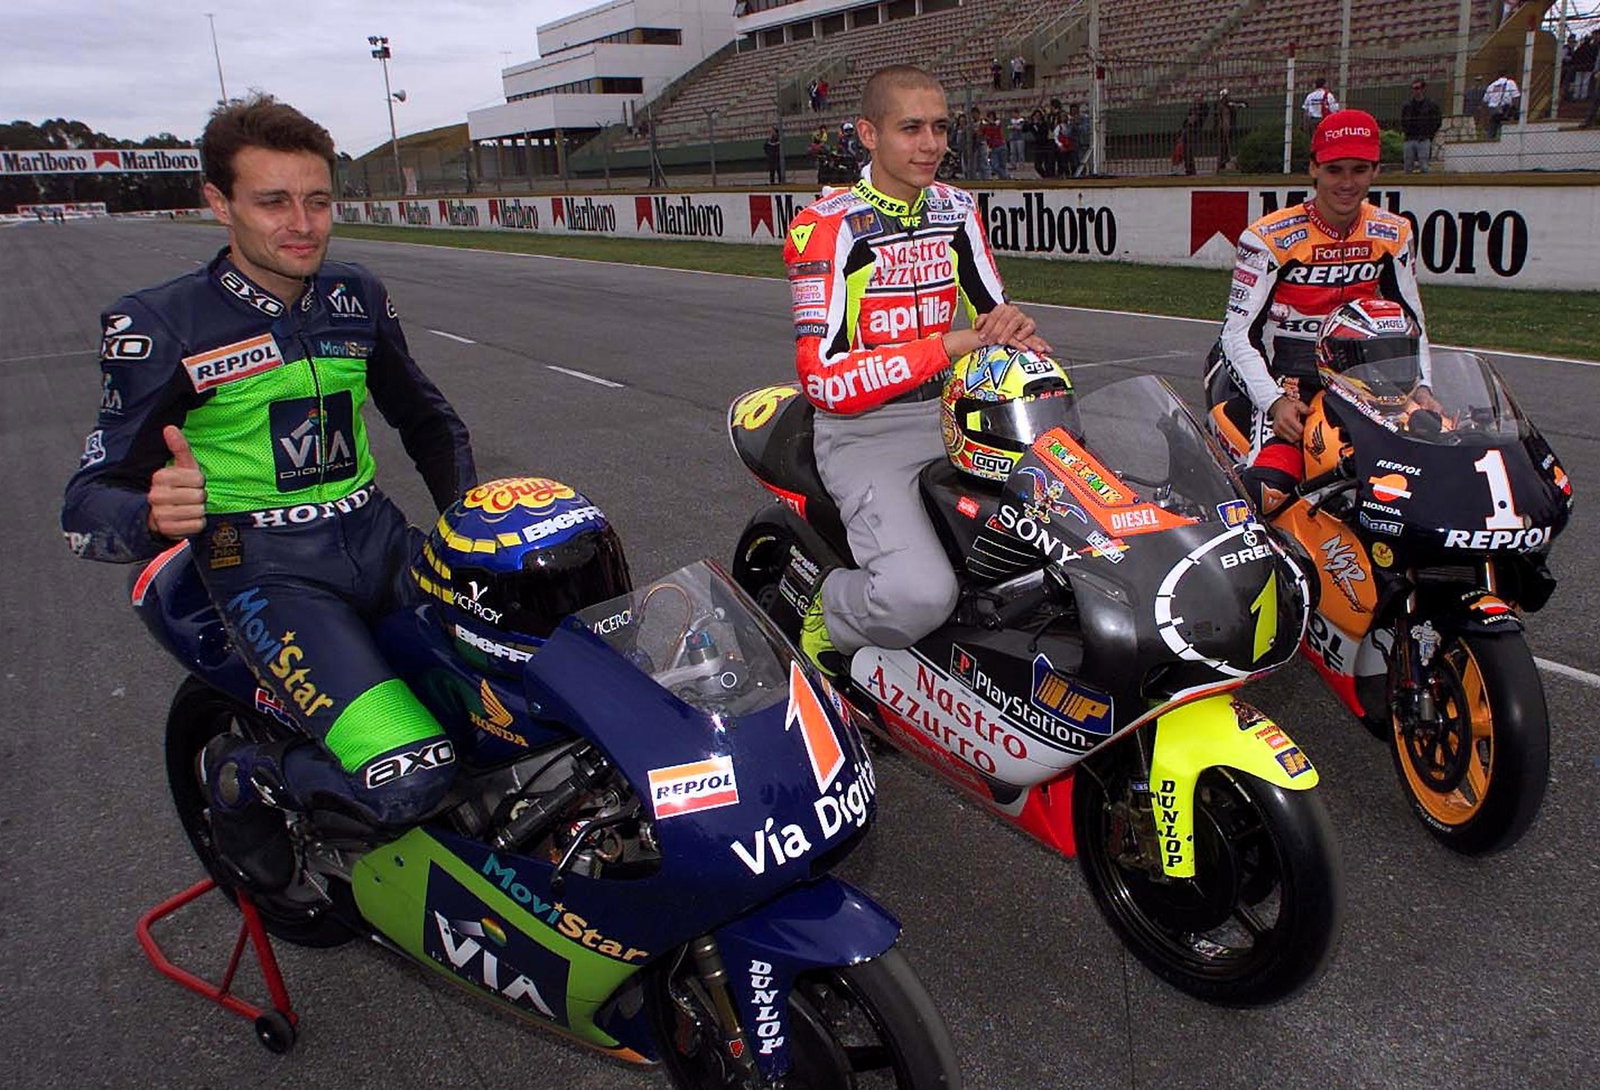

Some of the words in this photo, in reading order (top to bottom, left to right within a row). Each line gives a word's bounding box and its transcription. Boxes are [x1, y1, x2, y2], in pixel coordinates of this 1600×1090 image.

[1324, 126, 1371, 142] Fortuna
[2, 152, 87, 172] Marlboro
[121, 152, 199, 170] Marlboro
[500, 198, 539, 229] Marlboro
[565, 197, 617, 232] Marlboro
[654, 196, 724, 237] Marlboro
[978, 192, 1117, 256] arlboro
[1307, 203, 1339, 239] Fortuna
[881, 240, 946, 268] Nastro
[1314, 246, 1370, 261] Fortuna
[869, 260, 953, 287] Azzurro
[869, 295, 952, 339] aprilia
[196, 345, 277, 382] REPSOL
[806, 355, 912, 409] aprilia
[280, 430, 351, 468] VIA
[975, 455, 1013, 472] agv
[280, 461, 354, 480] DIGITAL
[1376, 459, 1422, 477] REPSOL
[251, 485, 376, 529] HOND
[1362, 500, 1403, 517] HONDA
[1473, 449, 1525, 531] 1
[998, 504, 1083, 567] SONY
[1111, 508, 1160, 530] DIESEL
[1369, 521, 1399, 535] GAS
[450, 591, 503, 625] VICEROY
[1250, 568, 1278, 664] 1
[225, 586, 334, 718] MoviStar
[784, 660, 846, 796] 1
[866, 664, 997, 774] Azzurro
[916, 663, 1028, 760] Nastro
[975, 671, 1087, 748] PlayStation
[468, 711, 530, 748] HONDA
[656, 773, 733, 800] REPSOL
[1160, 779, 1183, 868] DUNLOP
[730, 817, 812, 876] Vía
[481, 852, 650, 962] MoviStar
[433, 909, 557, 1021] VIA
[748, 959, 785, 1055] DUNLOP
